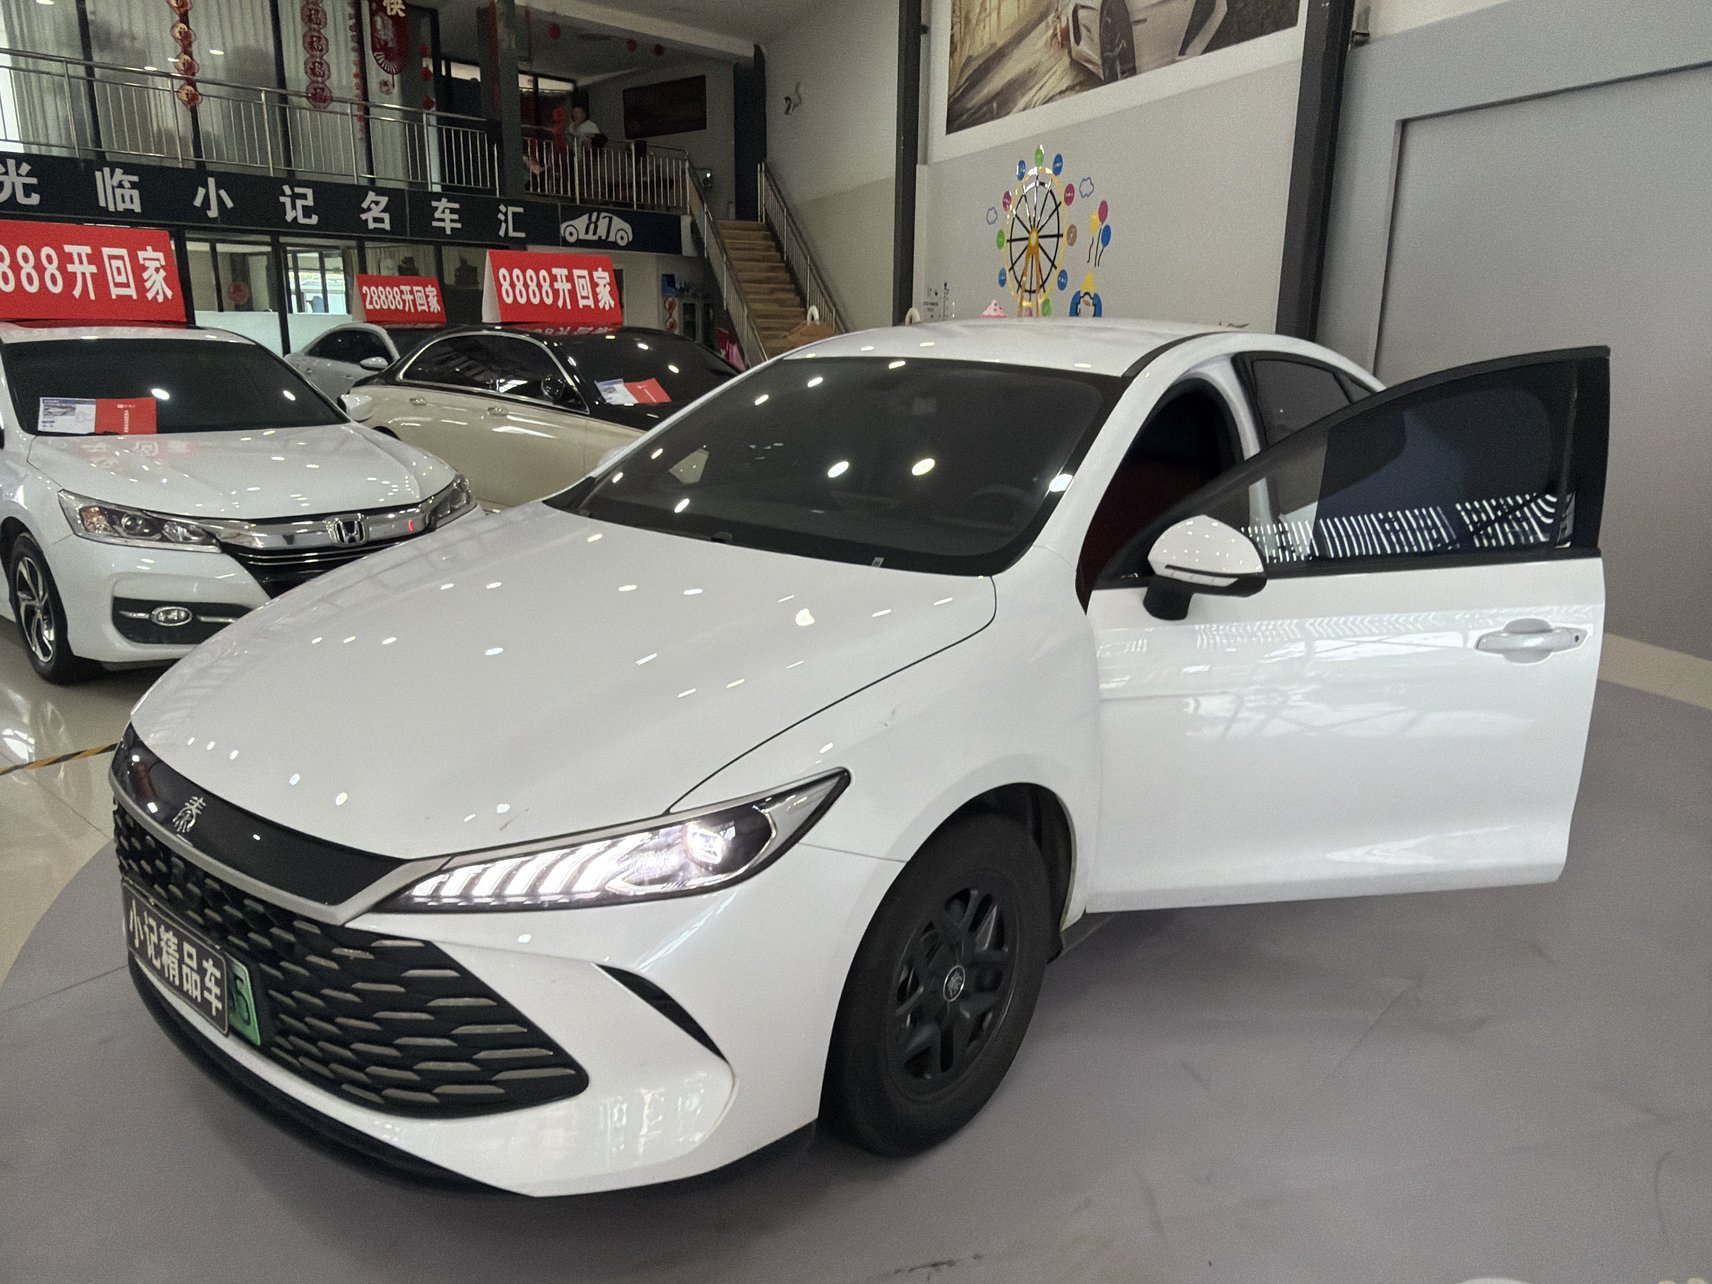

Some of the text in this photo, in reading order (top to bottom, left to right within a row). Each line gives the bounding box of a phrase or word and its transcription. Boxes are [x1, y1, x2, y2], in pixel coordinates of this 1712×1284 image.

[0, 157, 527, 239] 光临小记名车汇
[0, 244, 173, 303] 888开回家
[362, 284, 441, 313] 28888开回家
[498, 267, 615, 311] 8888开回家
[129, 899, 223, 1017] 小记精品车
